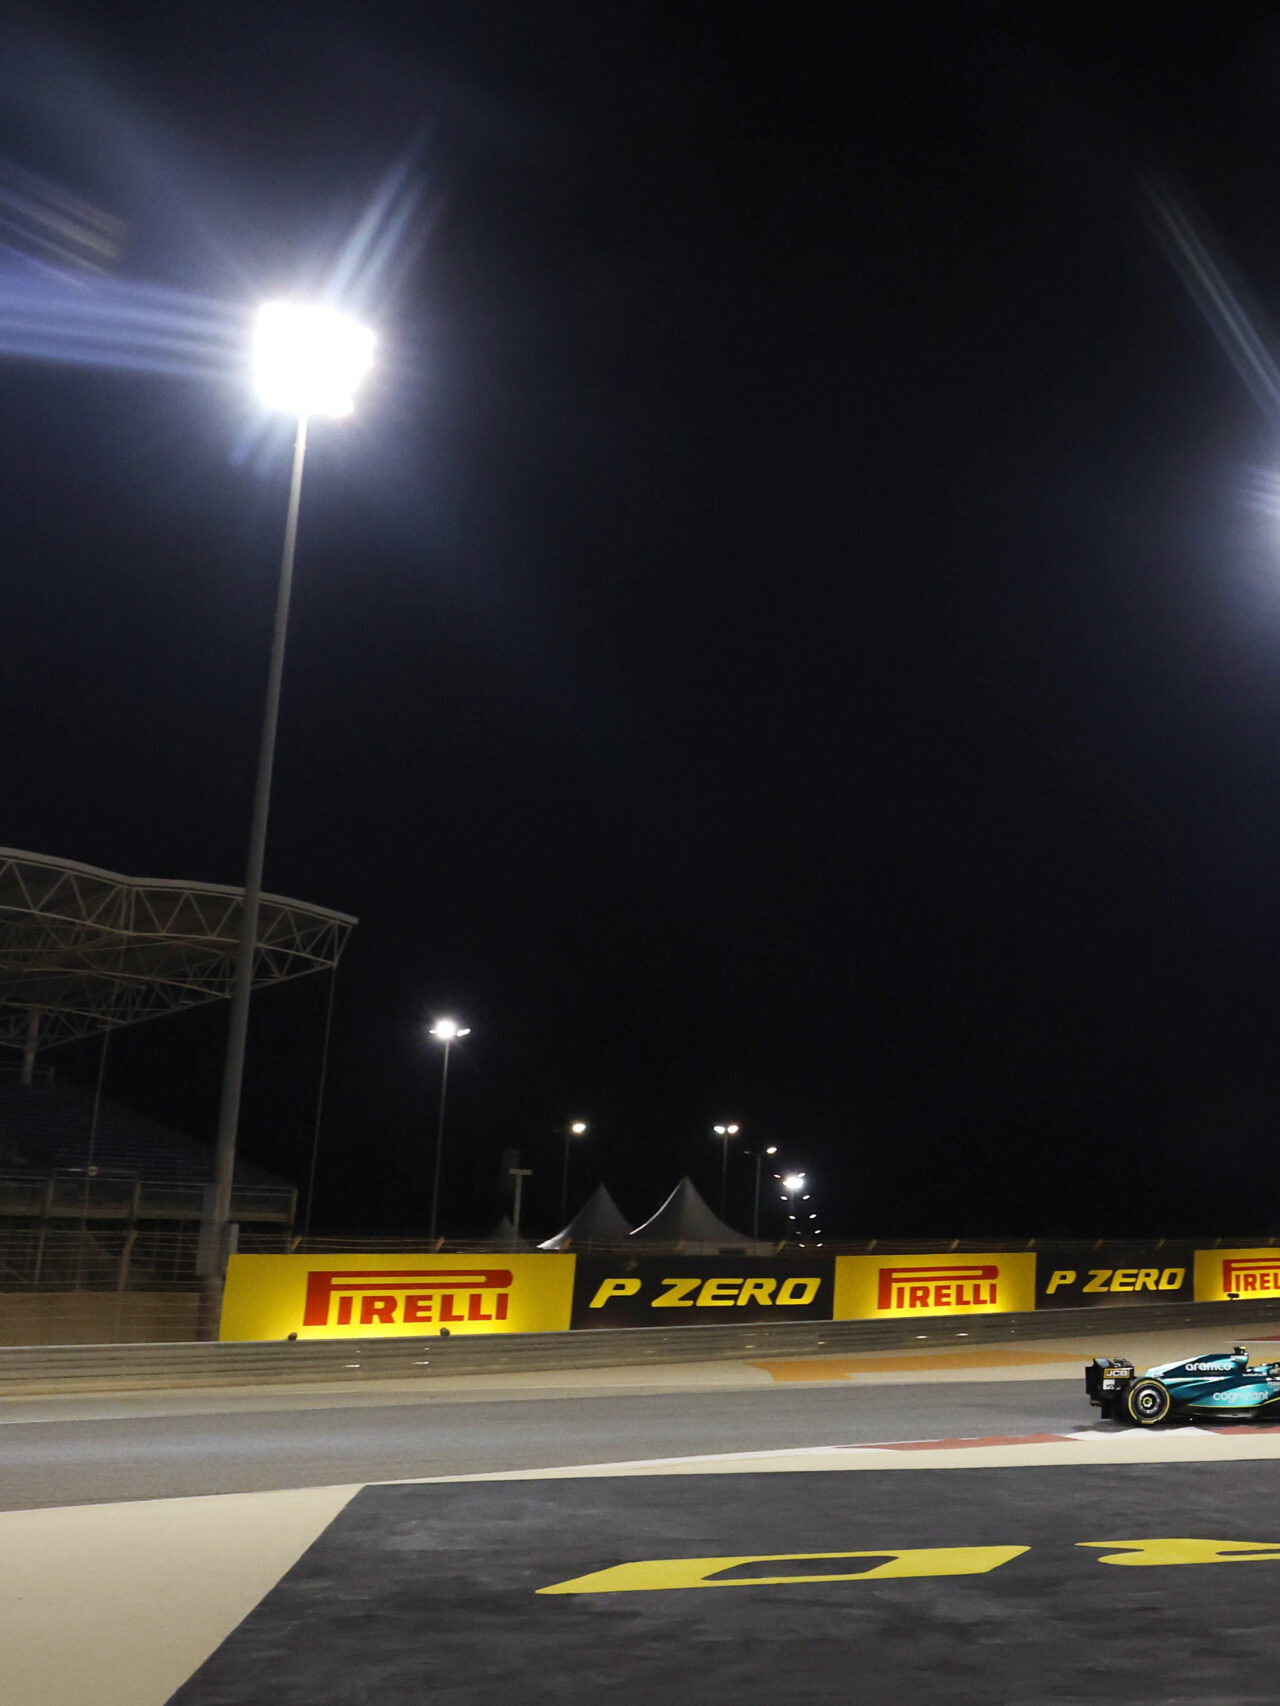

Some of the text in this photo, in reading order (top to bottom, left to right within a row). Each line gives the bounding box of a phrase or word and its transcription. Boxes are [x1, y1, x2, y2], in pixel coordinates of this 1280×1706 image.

[588, 1277, 822, 1309] P ZERO
[877, 1265, 999, 1310] PIRELLI
[1045, 1267, 1186, 1295] P ZERO
[303, 1269, 514, 1327] PIRELLI
[1105, 1369, 1129, 1377] JCB
[1184, 1361, 1234, 1372] aramco
[1212, 1390, 1270, 1404] cognant
